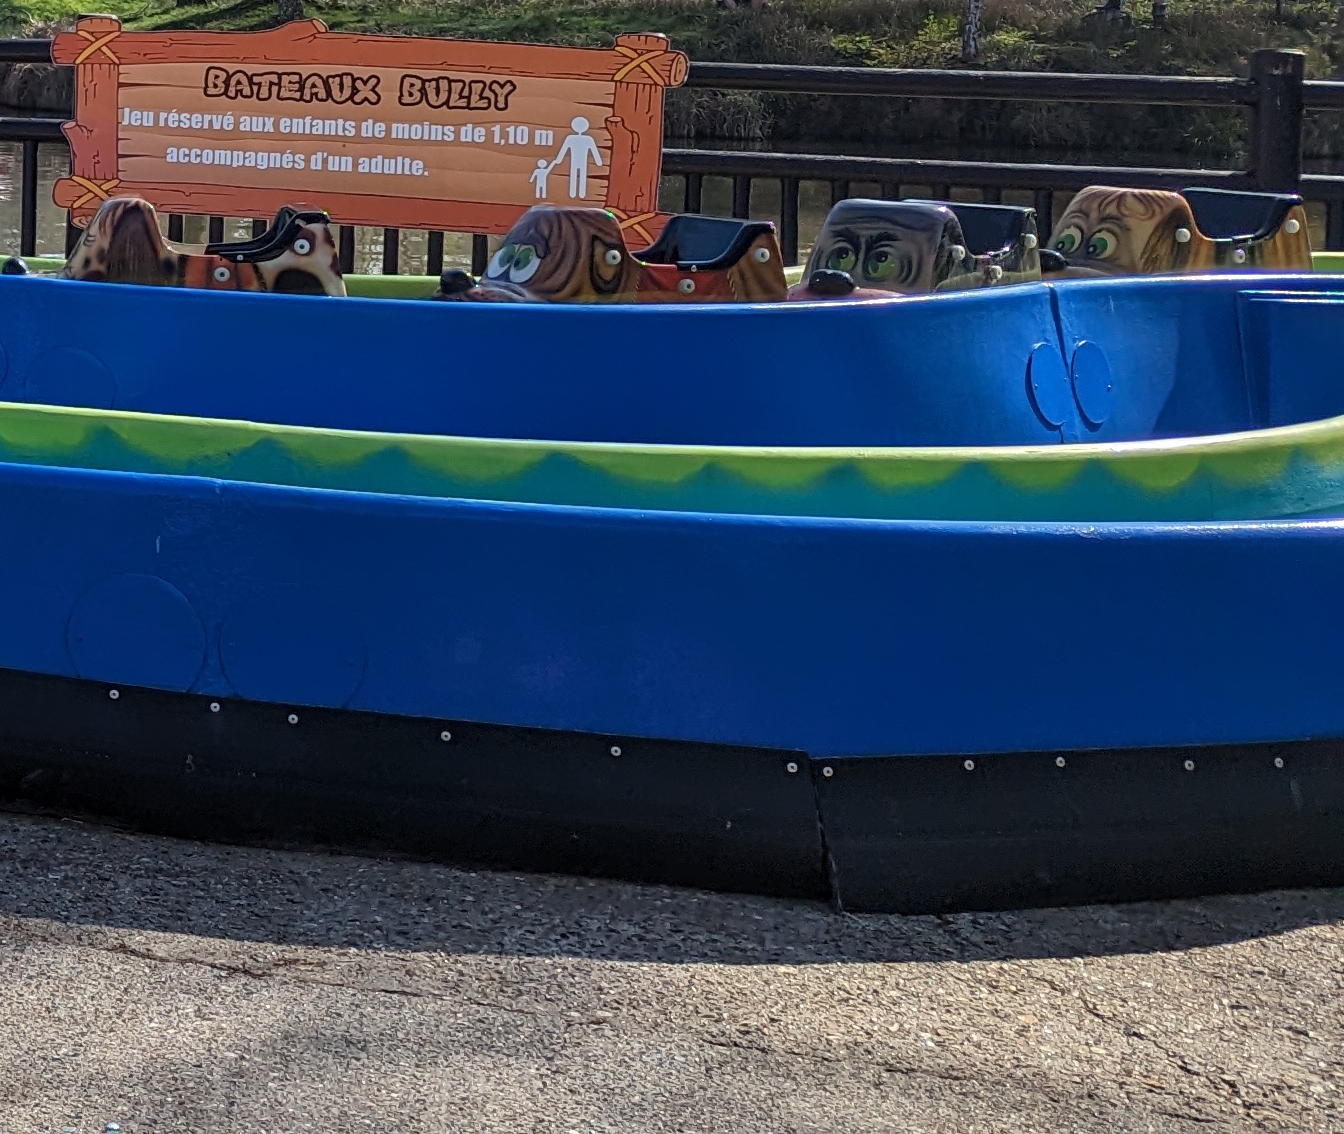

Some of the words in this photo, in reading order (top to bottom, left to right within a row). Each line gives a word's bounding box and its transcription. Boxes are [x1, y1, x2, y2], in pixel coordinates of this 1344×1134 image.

[203, 66, 381, 106] BATEAUX
[398, 74, 516, 111] BULLY
[122, 107, 154, 127] Jeu
[159, 108, 234, 131] réservé
[239, 115, 275, 133] aux
[279, 116, 356, 138] enfants
[361, 119, 386, 139] de
[391, 121, 455, 142] moins
[460, 123, 486, 143] de
[491, 125, 529, 146] 1,10
[534, 130, 554, 146] m
[166, 147, 305, 170] accompagnés
[310, 151, 353, 172] d’un
[358, 155, 429, 177] adulte.
